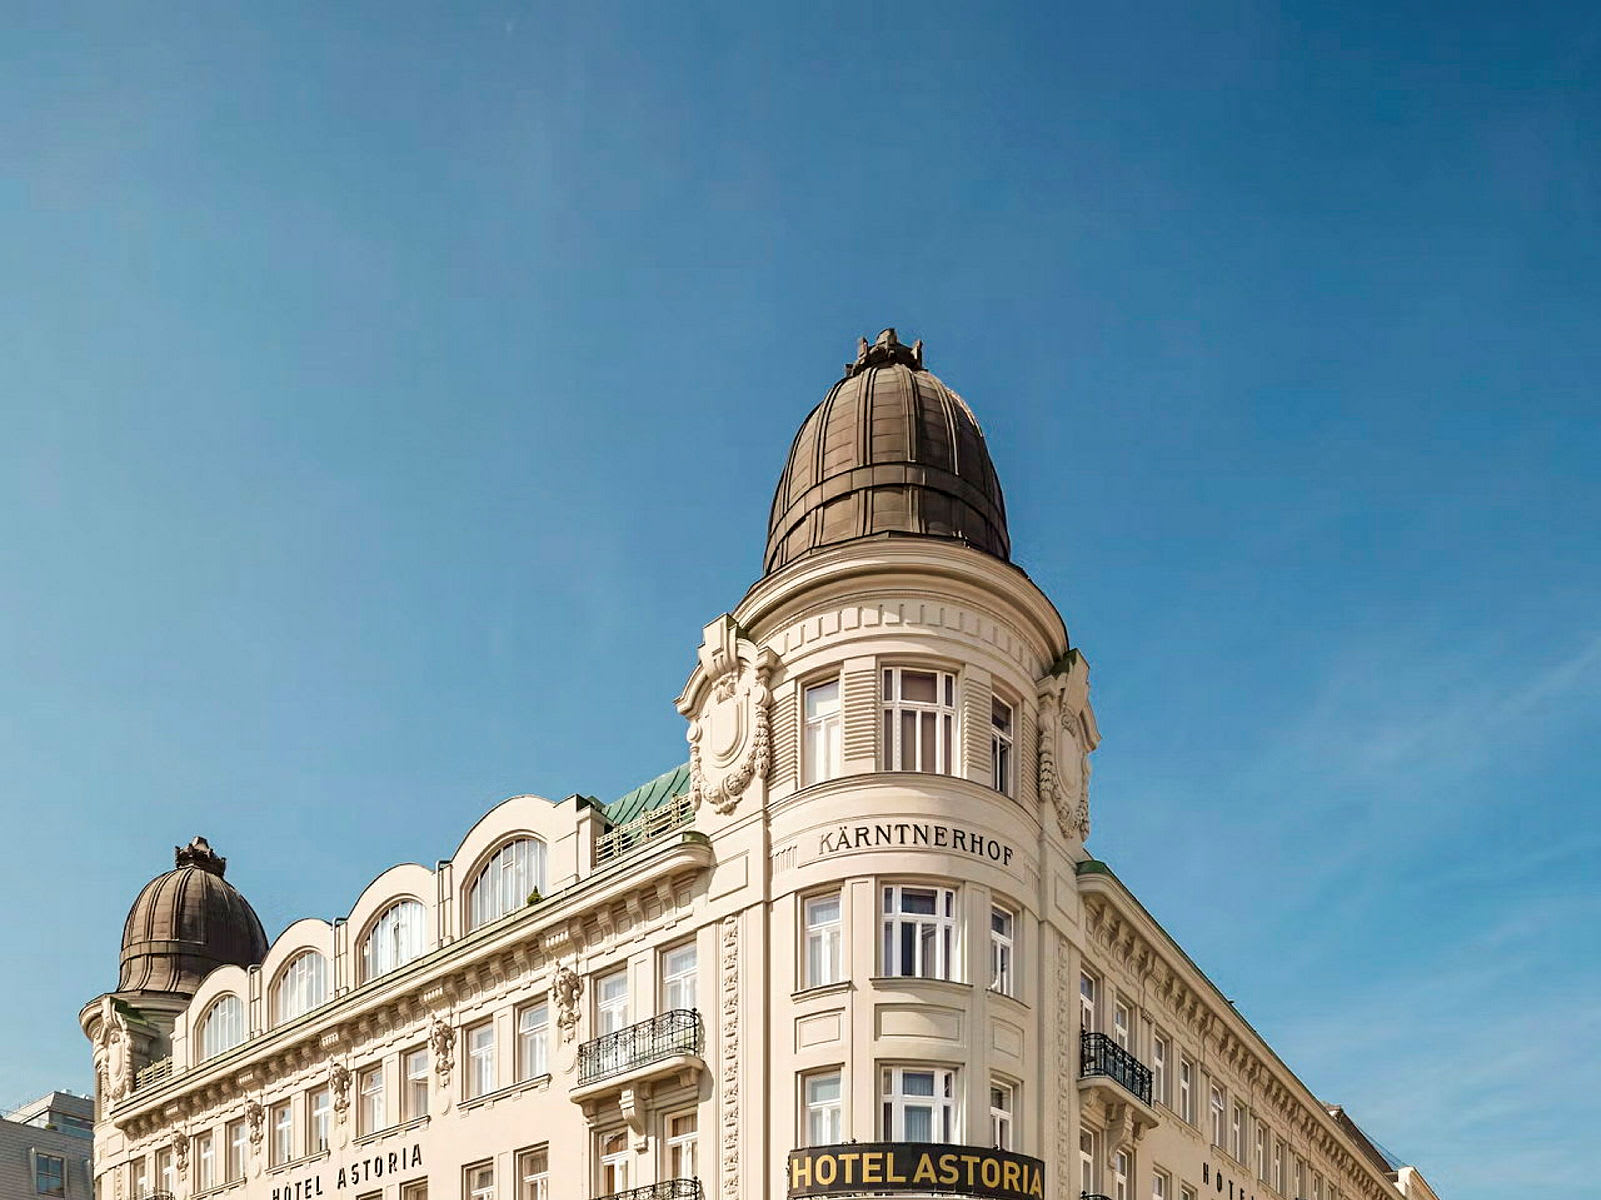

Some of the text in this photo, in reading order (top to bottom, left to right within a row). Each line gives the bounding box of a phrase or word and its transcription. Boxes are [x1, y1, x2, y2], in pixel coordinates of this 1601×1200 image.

[819, 824, 1014, 867] KÄRNTNERHOF
[337, 1144, 422, 1189] ASTORIA
[792, 1151, 1043, 1200] HOTEL ASTORIA
